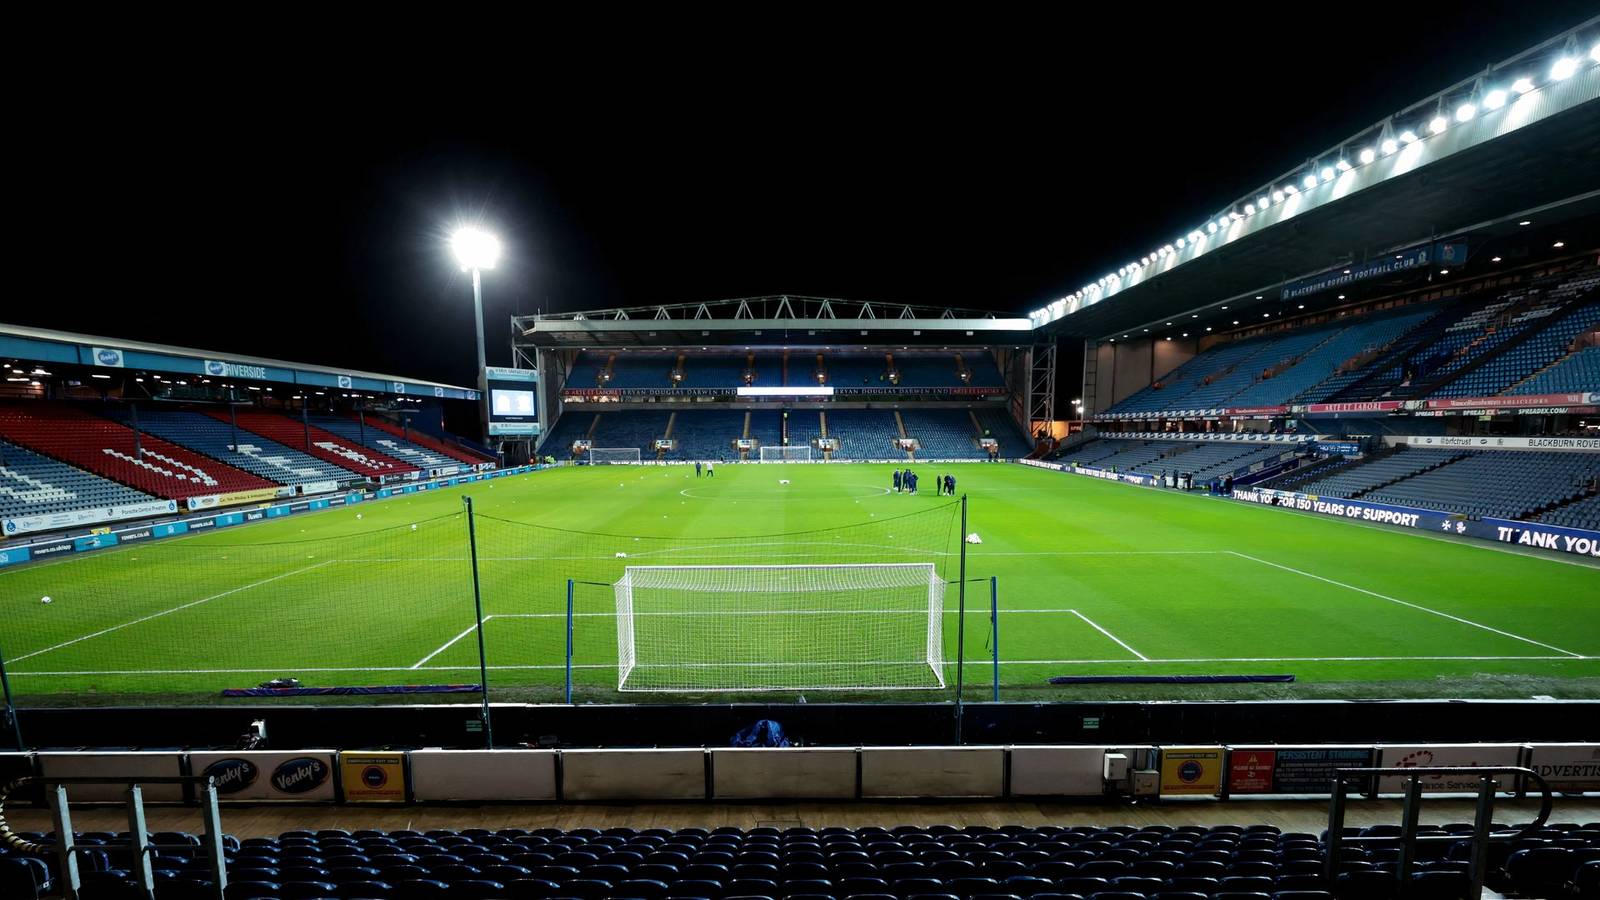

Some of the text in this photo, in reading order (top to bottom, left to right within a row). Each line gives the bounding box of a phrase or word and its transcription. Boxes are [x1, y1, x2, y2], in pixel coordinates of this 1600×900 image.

[1291, 259, 1415, 297] BLACKBURN ROVERS FOOTBALL CLUB
[225, 363, 266, 379] RIVERSIDE
[1528, 438, 1600, 448] BLACKBURN ROVE
[1233, 490, 1259, 503] THANK
[1296, 498, 1312, 511] 150
[1313, 500, 1345, 516] YEARS
[1346, 505, 1362, 518] OF
[1363, 508, 1420, 528] SUPPORT
[214, 763, 250, 787] enky's
[277, 762, 321, 789] Venky's
